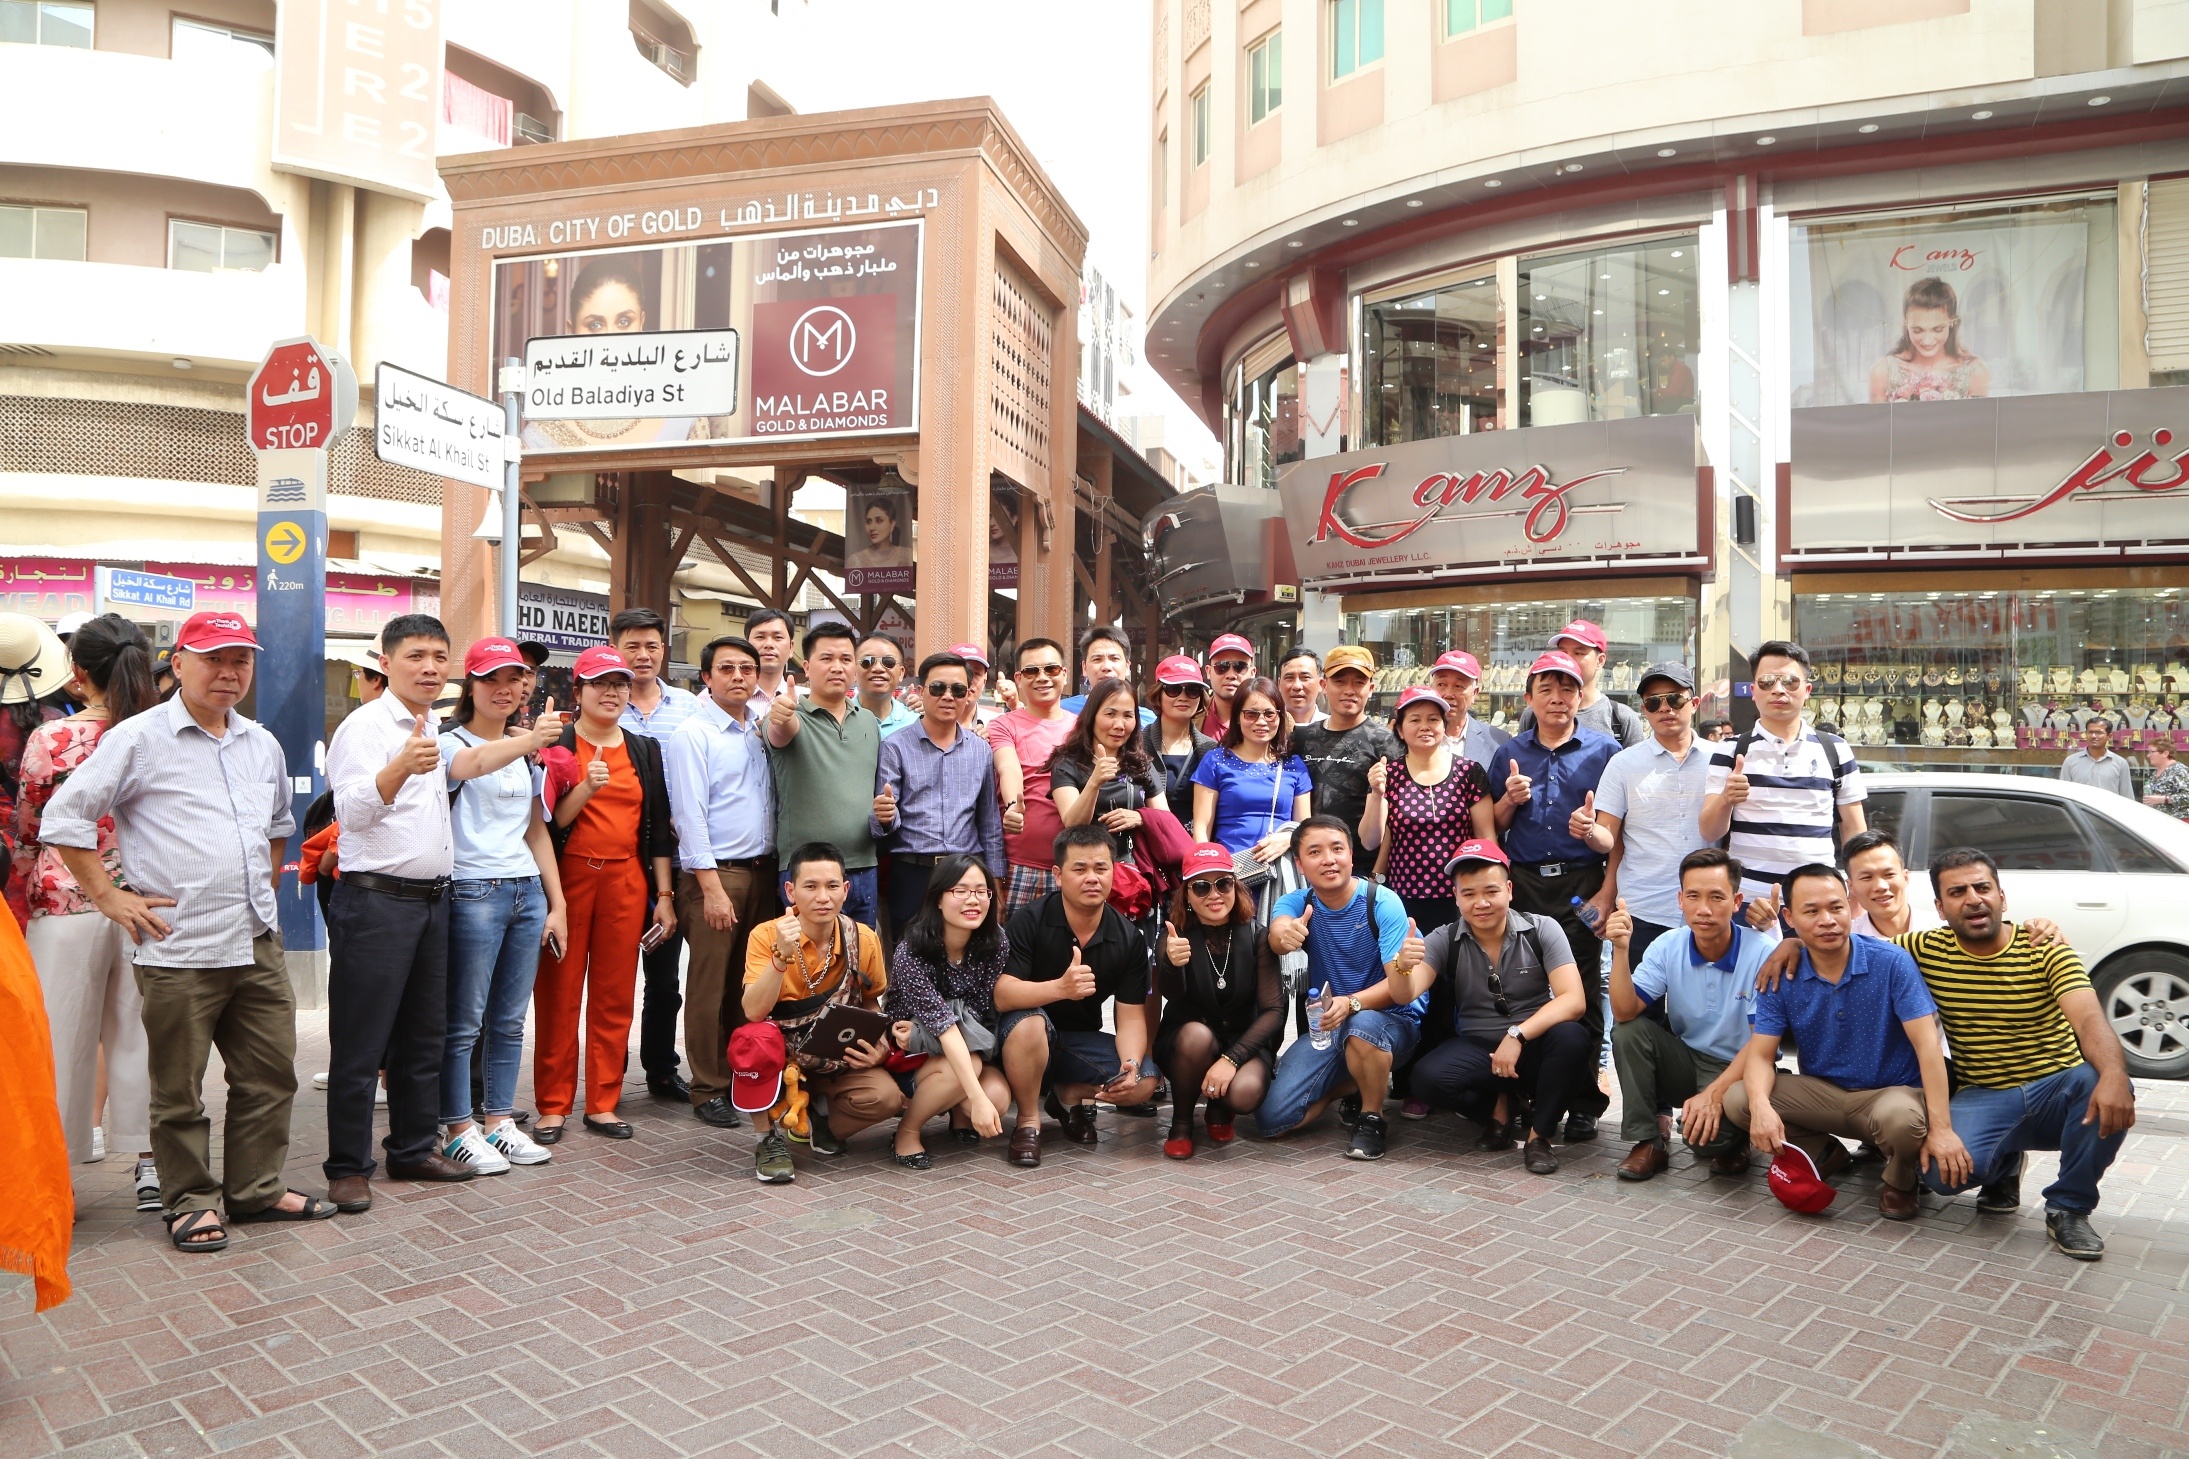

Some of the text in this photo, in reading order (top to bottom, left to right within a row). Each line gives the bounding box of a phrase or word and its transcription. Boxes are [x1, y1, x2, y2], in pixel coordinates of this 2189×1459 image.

[720, 187, 939, 231] دبي مدينة الذهب
[549, 216, 600, 245] CITY
[607, 213, 635, 238] OF
[641, 206, 702, 235] GOLD
[777, 243, 875, 264] مجوهرات من
[1889, 244, 1985, 271] Kanz
[755, 257, 897, 285] ملبار ذهب وألماس
[533, 342, 730, 378] شارع البلدية القديم
[262, 354, 321, 407] قف
[532, 383, 685, 407] Old Baladiya St
[756, 389, 888, 417] MALABAR
[385, 382, 501, 439] شارع سكة الخيل
[756, 414, 887, 432] GOLD & DIAMONDS
[266, 421, 319, 450] STOP
[382, 424, 489, 473] Sikkat Al Khail St
[1314, 462, 1628, 549] Kanz
[867, 570, 909, 579] MALABAR
[1326, 561, 1344, 569] KANZ
[1346, 558, 1366, 568] DUBAI
[1368, 554, 1408, 565] JEWELLERY
[112, 573, 191, 596] شارع سكة الخيل
[112, 588, 191, 607] Sikkat Al Khail Rd
[279, 581, 304, 591] 220m
[560, 636, 607, 648] TRADING
